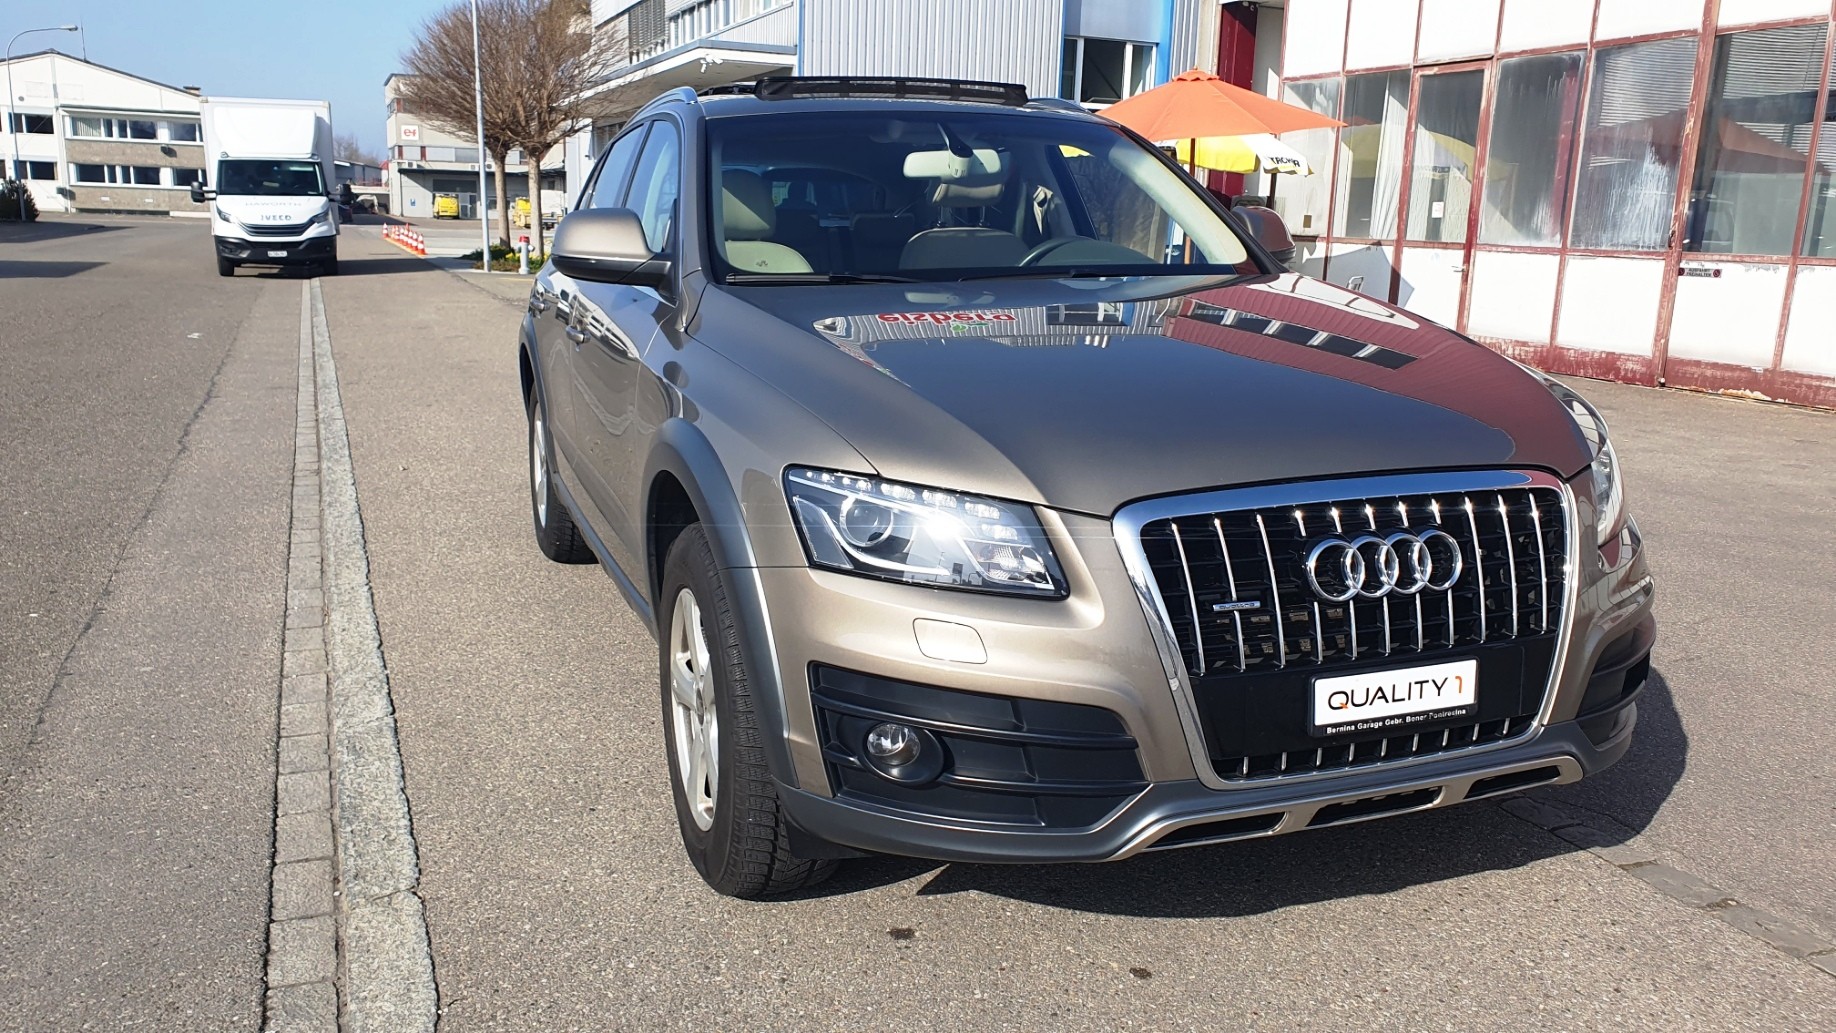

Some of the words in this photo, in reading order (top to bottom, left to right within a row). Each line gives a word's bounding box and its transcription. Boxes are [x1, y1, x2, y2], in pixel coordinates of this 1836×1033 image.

[1328, 676, 1449, 711] QUALITY
[1454, 675, 1463, 694] 1
[1326, 725, 1355, 734] Bernina
[1357, 720, 1383, 730] Garage
[1384, 717, 1404, 726] Gebr.
